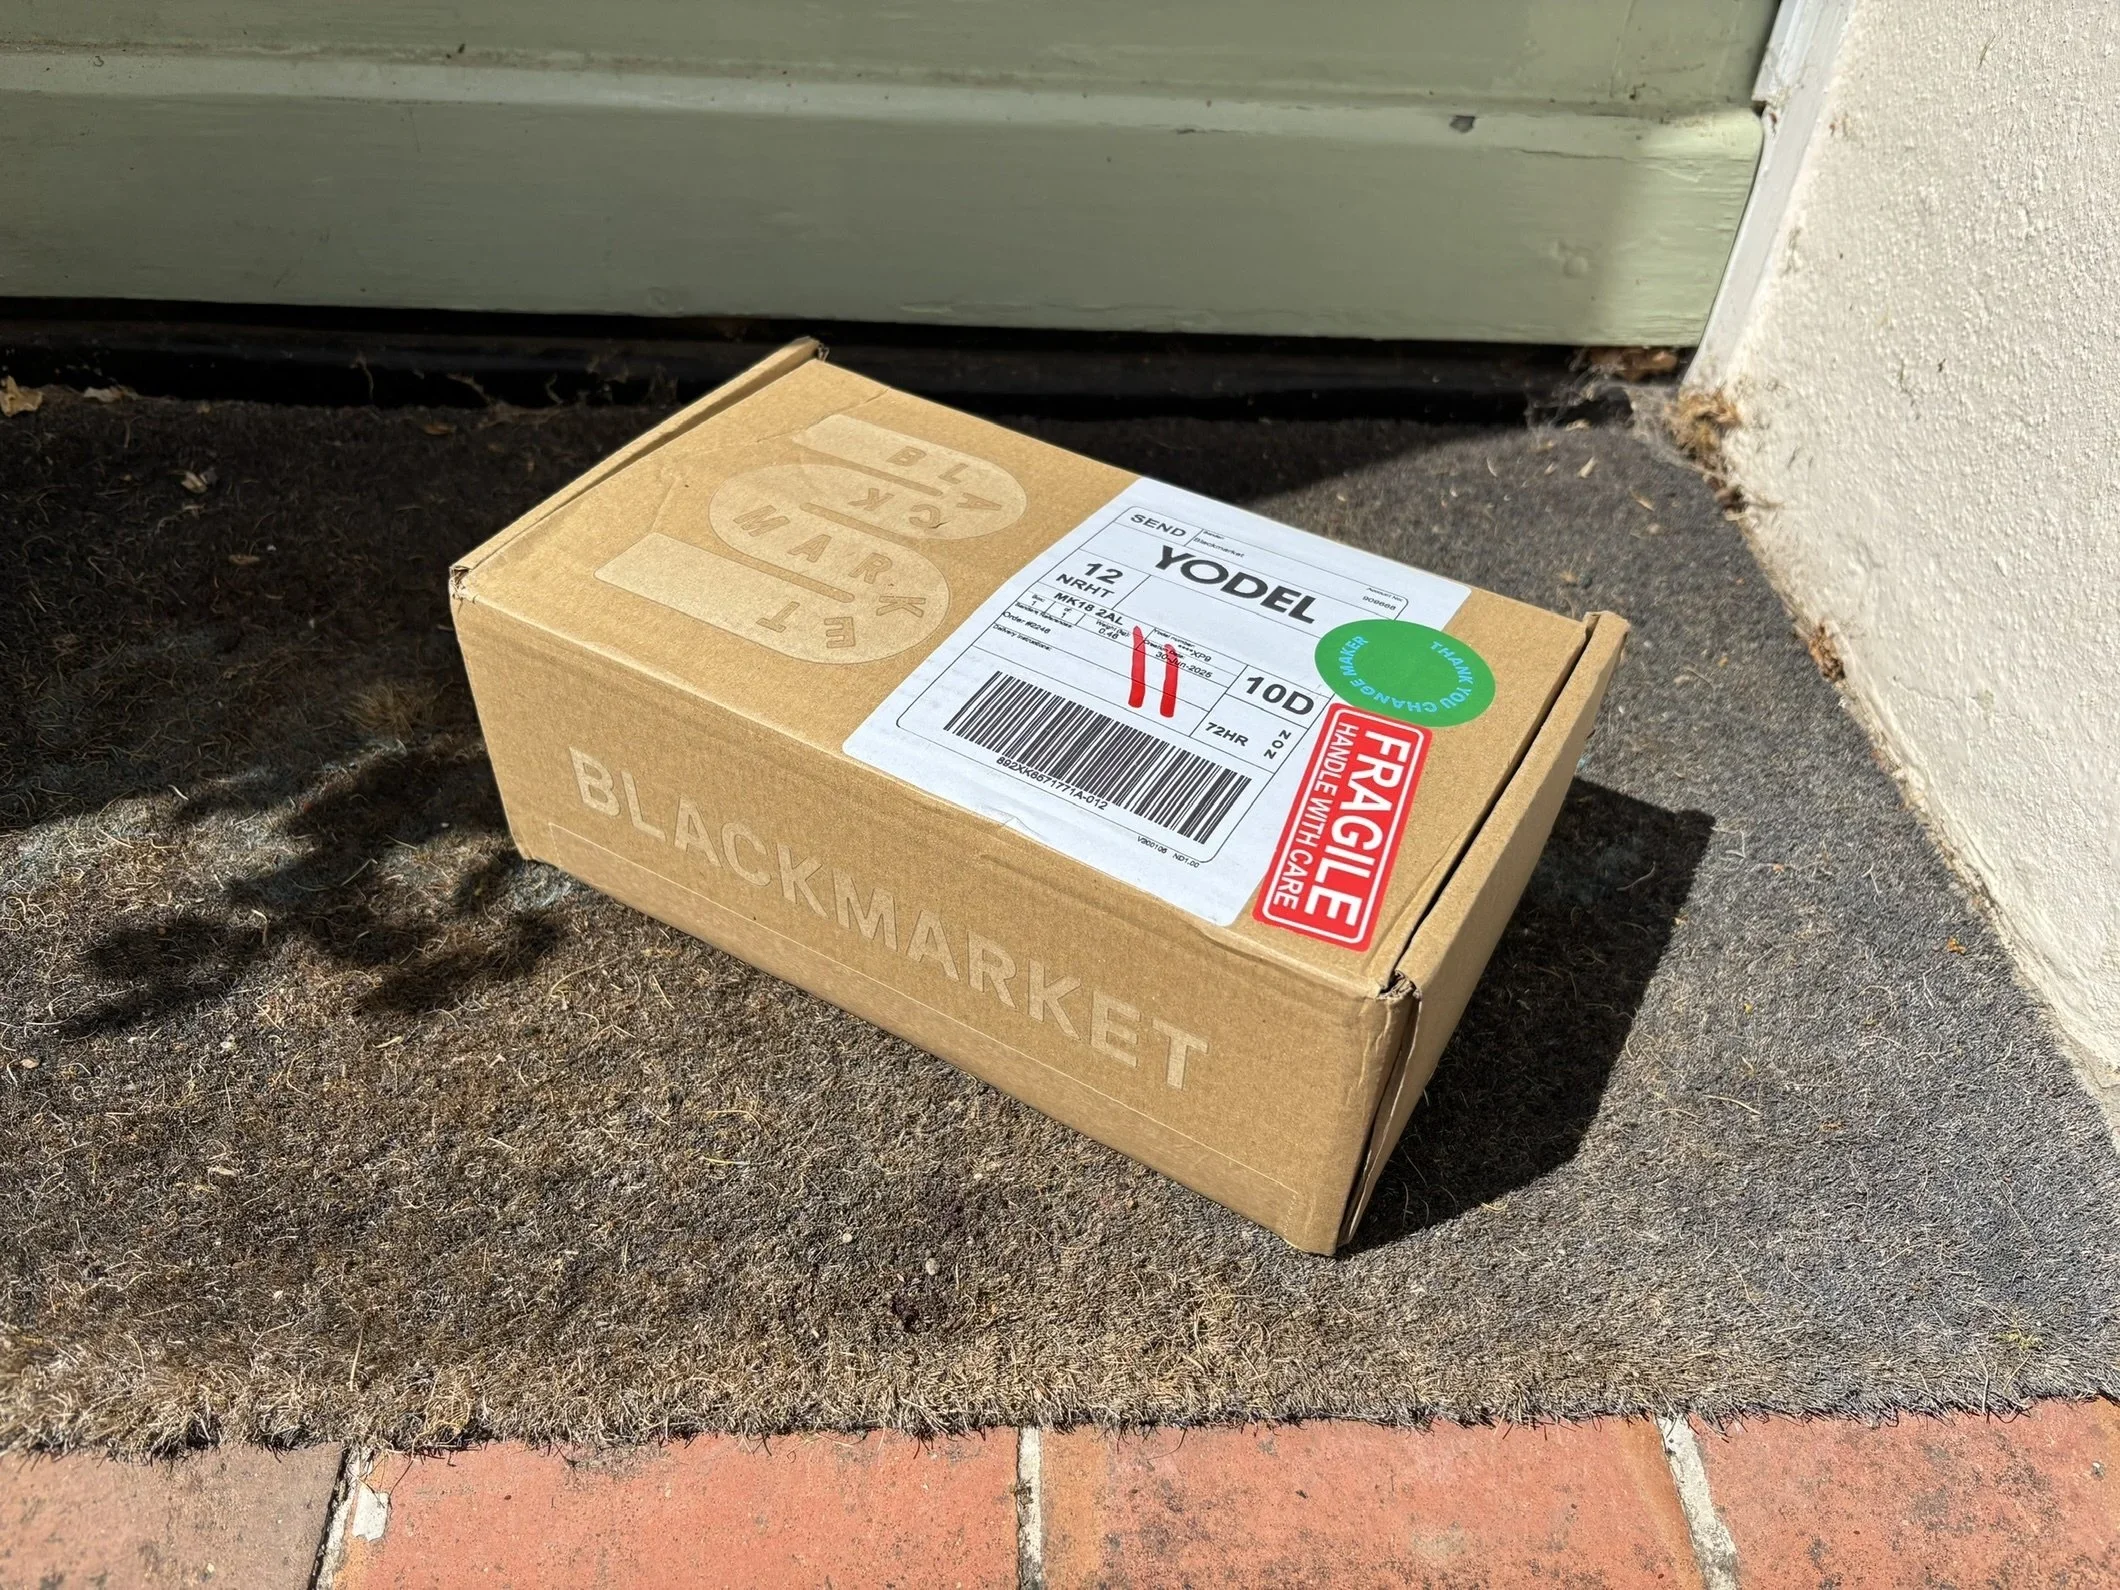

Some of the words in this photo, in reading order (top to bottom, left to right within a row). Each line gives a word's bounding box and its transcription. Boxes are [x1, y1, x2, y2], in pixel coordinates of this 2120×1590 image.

[850, 445, 1003, 530] BLACK
[1130, 514, 1187, 537] SEND
[1193, 537, 1245, 558] Blackmarket
[732, 504, 927, 650] MARKET
[1055, 573, 1116, 598] NRHT
[1084, 563, 1124, 585] 12
[1155, 544, 1317, 625] YODEL
[1003, 611, 1026, 624] Order
[1053, 592, 1096, 612] MK18
[1095, 608, 1124, 626] 2AL
[1338, 635, 1369, 677] MAKER
[1429, 641, 1474, 685] THANK
[1246, 676, 1315, 715] 10D
[1350, 678, 1438, 713] CHANGE
[1439, 687, 1473, 709] YOU
[1205, 722, 1249, 747] 72HR
[1313, 721, 1360, 797] HANDLE
[1296, 796, 1332, 848] WITH
[1304, 730, 1412, 927] FRAGILE
[1272, 849, 1315, 911] CARE
[568, 746, 1210, 1091] BLACKMARKET
